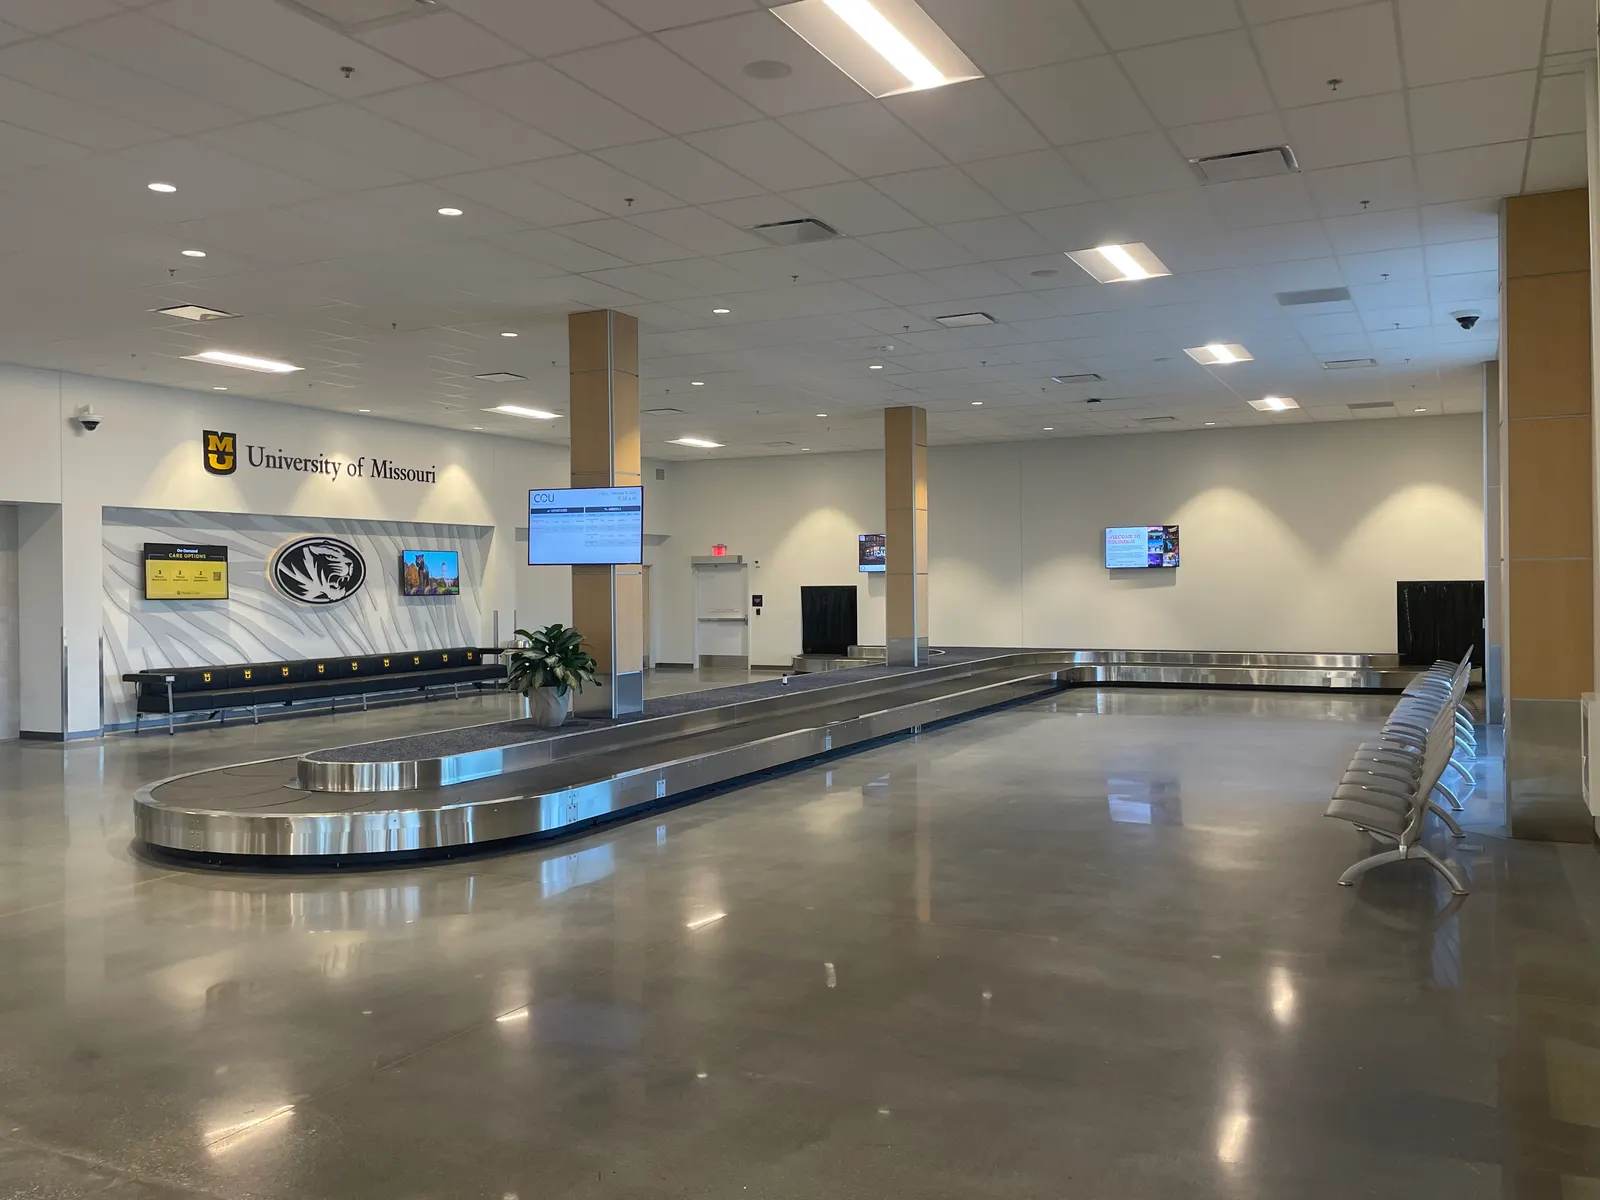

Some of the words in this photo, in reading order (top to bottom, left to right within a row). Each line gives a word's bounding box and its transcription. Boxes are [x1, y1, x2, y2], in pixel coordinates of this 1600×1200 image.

[246, 445, 341, 482] University
[346, 457, 365, 477] of
[370, 458, 436, 484] Missouri
